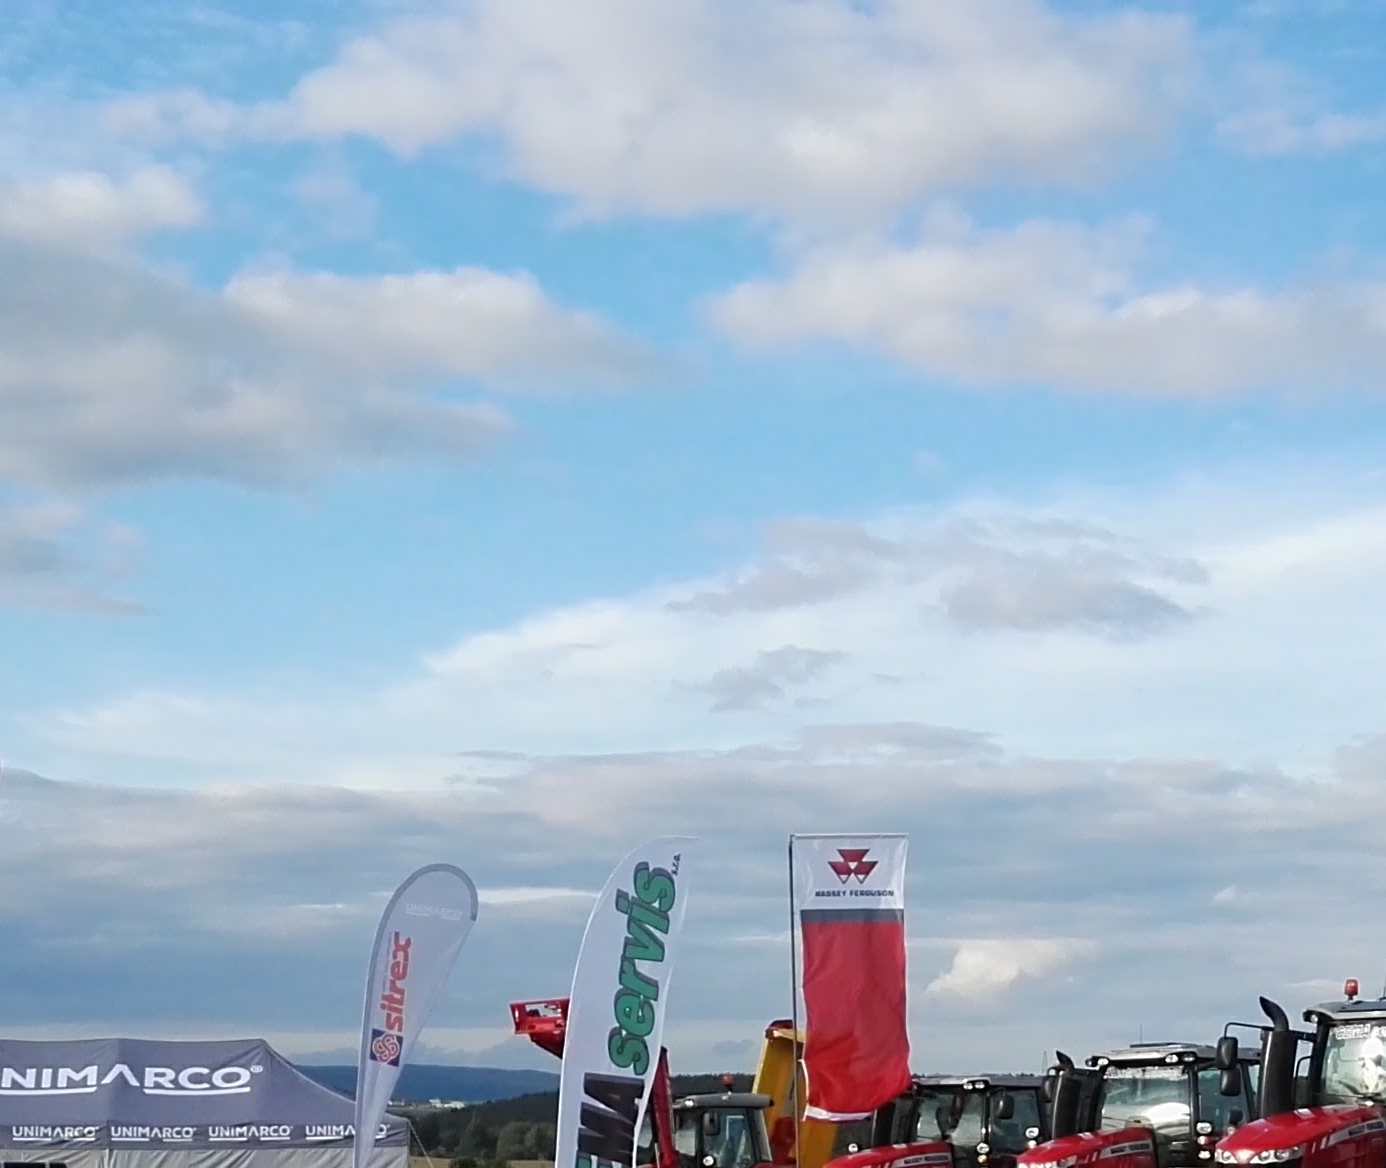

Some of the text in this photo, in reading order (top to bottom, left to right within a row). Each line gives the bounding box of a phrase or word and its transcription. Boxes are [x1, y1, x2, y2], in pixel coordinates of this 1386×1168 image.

[849, 889, 894, 897] FERGUSON
[380, 931, 412, 1032] sitrex
[13, 1126, 96, 1138] UNIMARCO
[111, 1126, 193, 1138] UNIMARCO
[208, 1125, 291, 1137] UNIMARCO
[305, 1124, 387, 1139] UNIMAO
